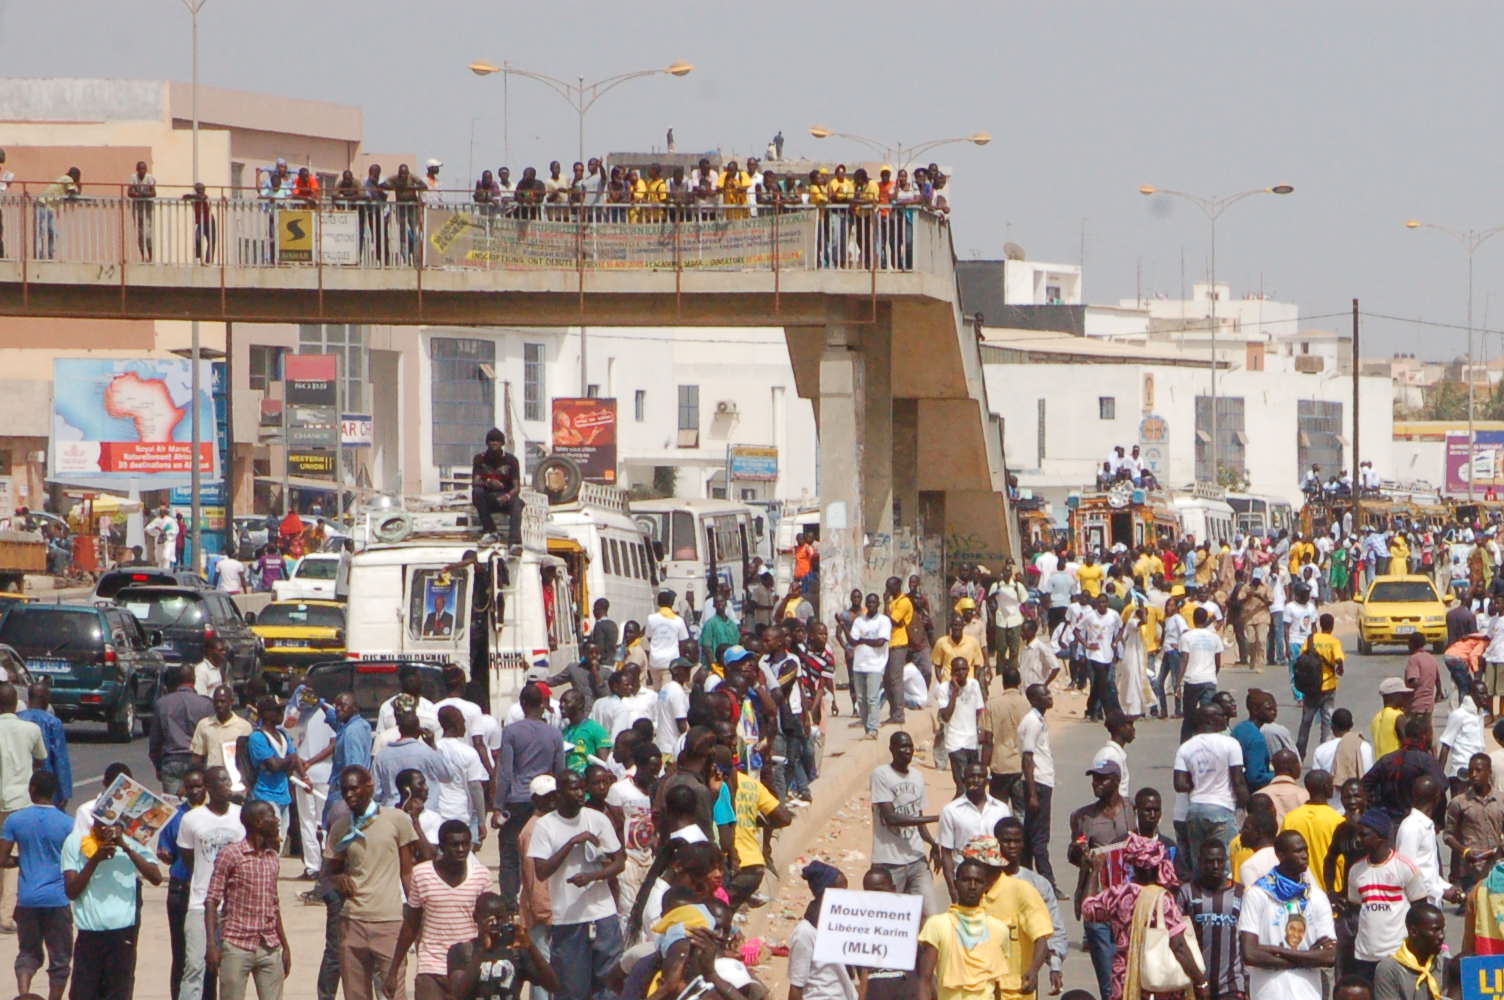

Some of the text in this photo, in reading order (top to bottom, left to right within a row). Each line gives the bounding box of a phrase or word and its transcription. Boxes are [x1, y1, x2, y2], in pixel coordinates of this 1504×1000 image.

[829, 903, 912, 922] Mouvement
[1365, 902, 1392, 913] YORK
[827, 922, 909, 938] Libérez Karim
[842, 941, 888, 959] (MLK)
